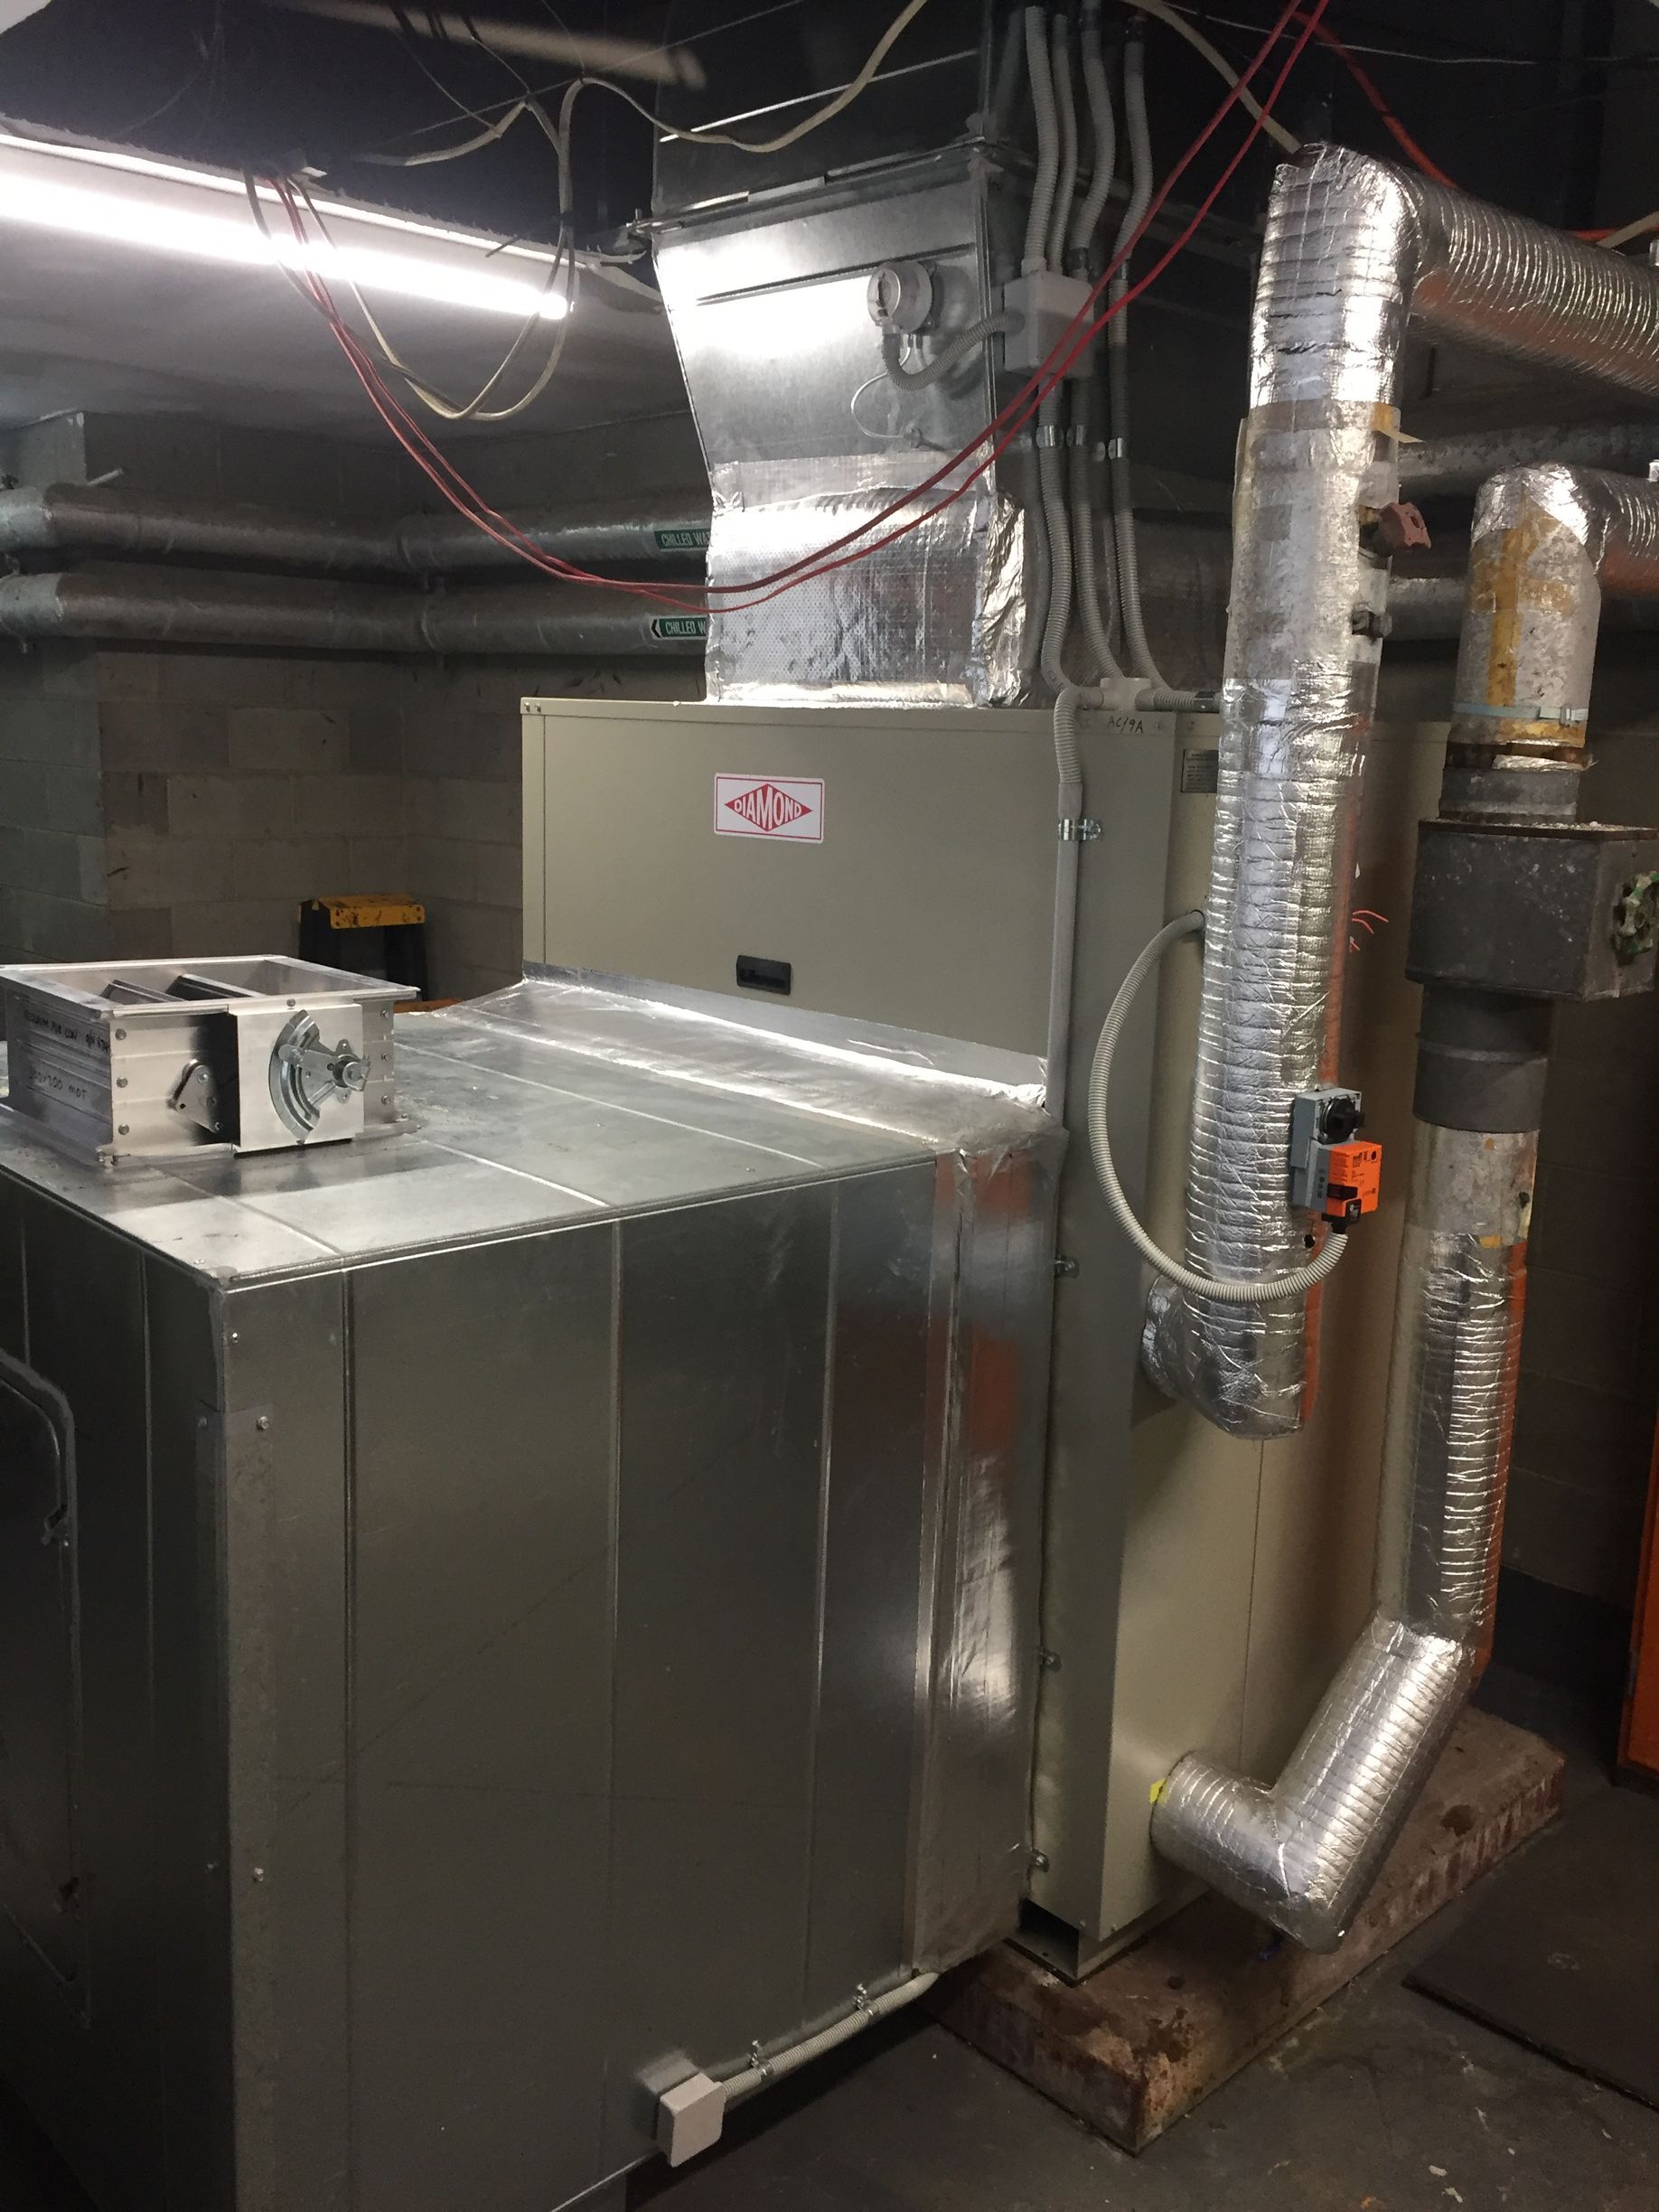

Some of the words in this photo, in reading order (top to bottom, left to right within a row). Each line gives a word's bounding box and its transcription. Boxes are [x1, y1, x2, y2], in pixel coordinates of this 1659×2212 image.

[661, 532, 694, 547] CHILLED
[665, 621, 697, 635] CHILLED
[734, 785, 802, 830] DIAMOND
